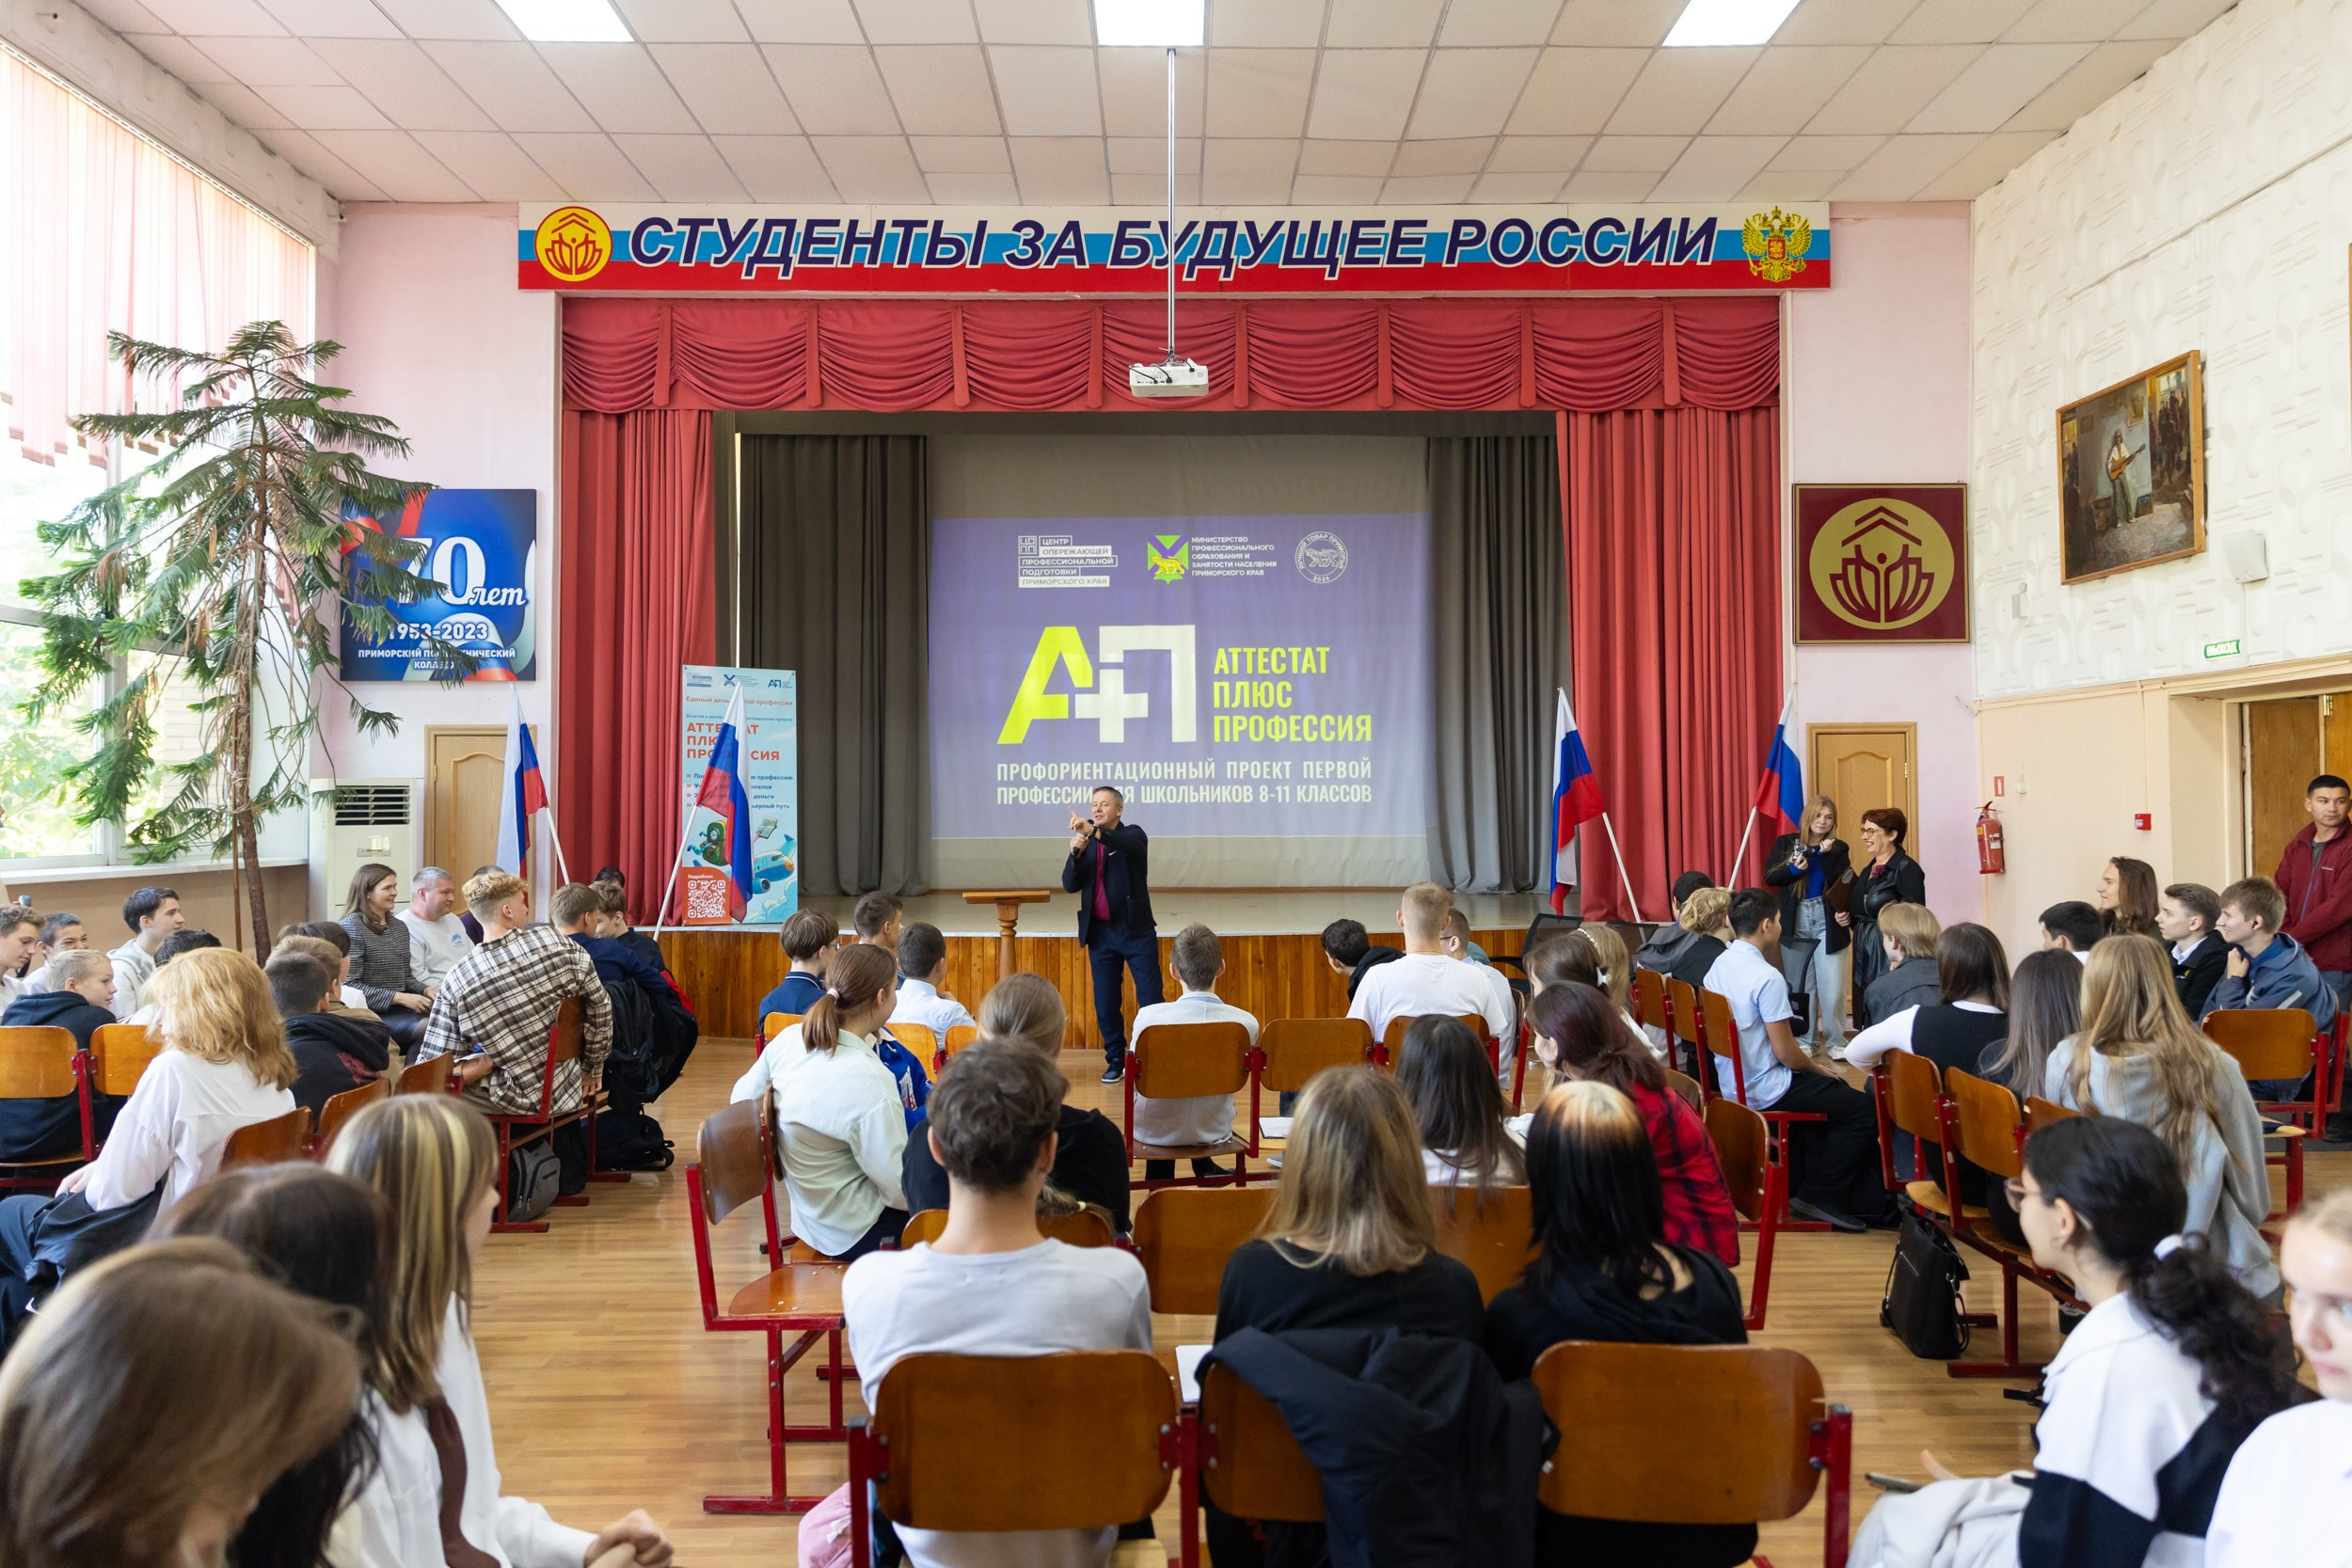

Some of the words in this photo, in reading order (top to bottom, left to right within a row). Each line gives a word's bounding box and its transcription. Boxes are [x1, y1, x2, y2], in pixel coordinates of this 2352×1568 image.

[629, 216, 989, 280] СТУДЕНТЫ
[1003, 218, 1089, 270] ЗА
[1106, 219, 1428, 281] БУДУЩЕЕ
[1442, 216, 1718, 268] РОССИИ
[1022, 557, 1114, 565] ПРОФЕССИОНАЛЬНОЙ
[1042, 547, 1108, 556] ОПЕРЕЖАЮЩЕЙ
[1297, 541, 1307, 570] ЛУЧШИЙ
[1307, 533, 1328, 543] ТОВАР
[1328, 535, 1346, 570] ПРИМОРЬЯ
[1022, 568, 1077, 577] ПОДГОТОВКИ
[469, 587, 526, 606] лет
[358, 648, 421, 657] ПРИМОРСКИЙ
[1214, 647, 1329, 674] АТТЕСТАТ
[1214, 681, 1293, 708] ПЛЮС
[1214, 714, 1372, 742] ПРОФЕССИЯ
[996, 758, 1216, 782] ПРОФОРИЕНТАЦИОННЫЙ
[1226, 761, 1293, 780] ПРОЕКТ
[1302, 757, 1372, 779] ПЕРВОЙ
[996, 786, 1092, 805] ПРОФЕССИИ
[1140, 785, 1253, 804] ШКОЛЬНИКОВ
[1259, 785, 1290, 803] 8-11
[1296, 784, 1373, 803] КЛАССОВ
